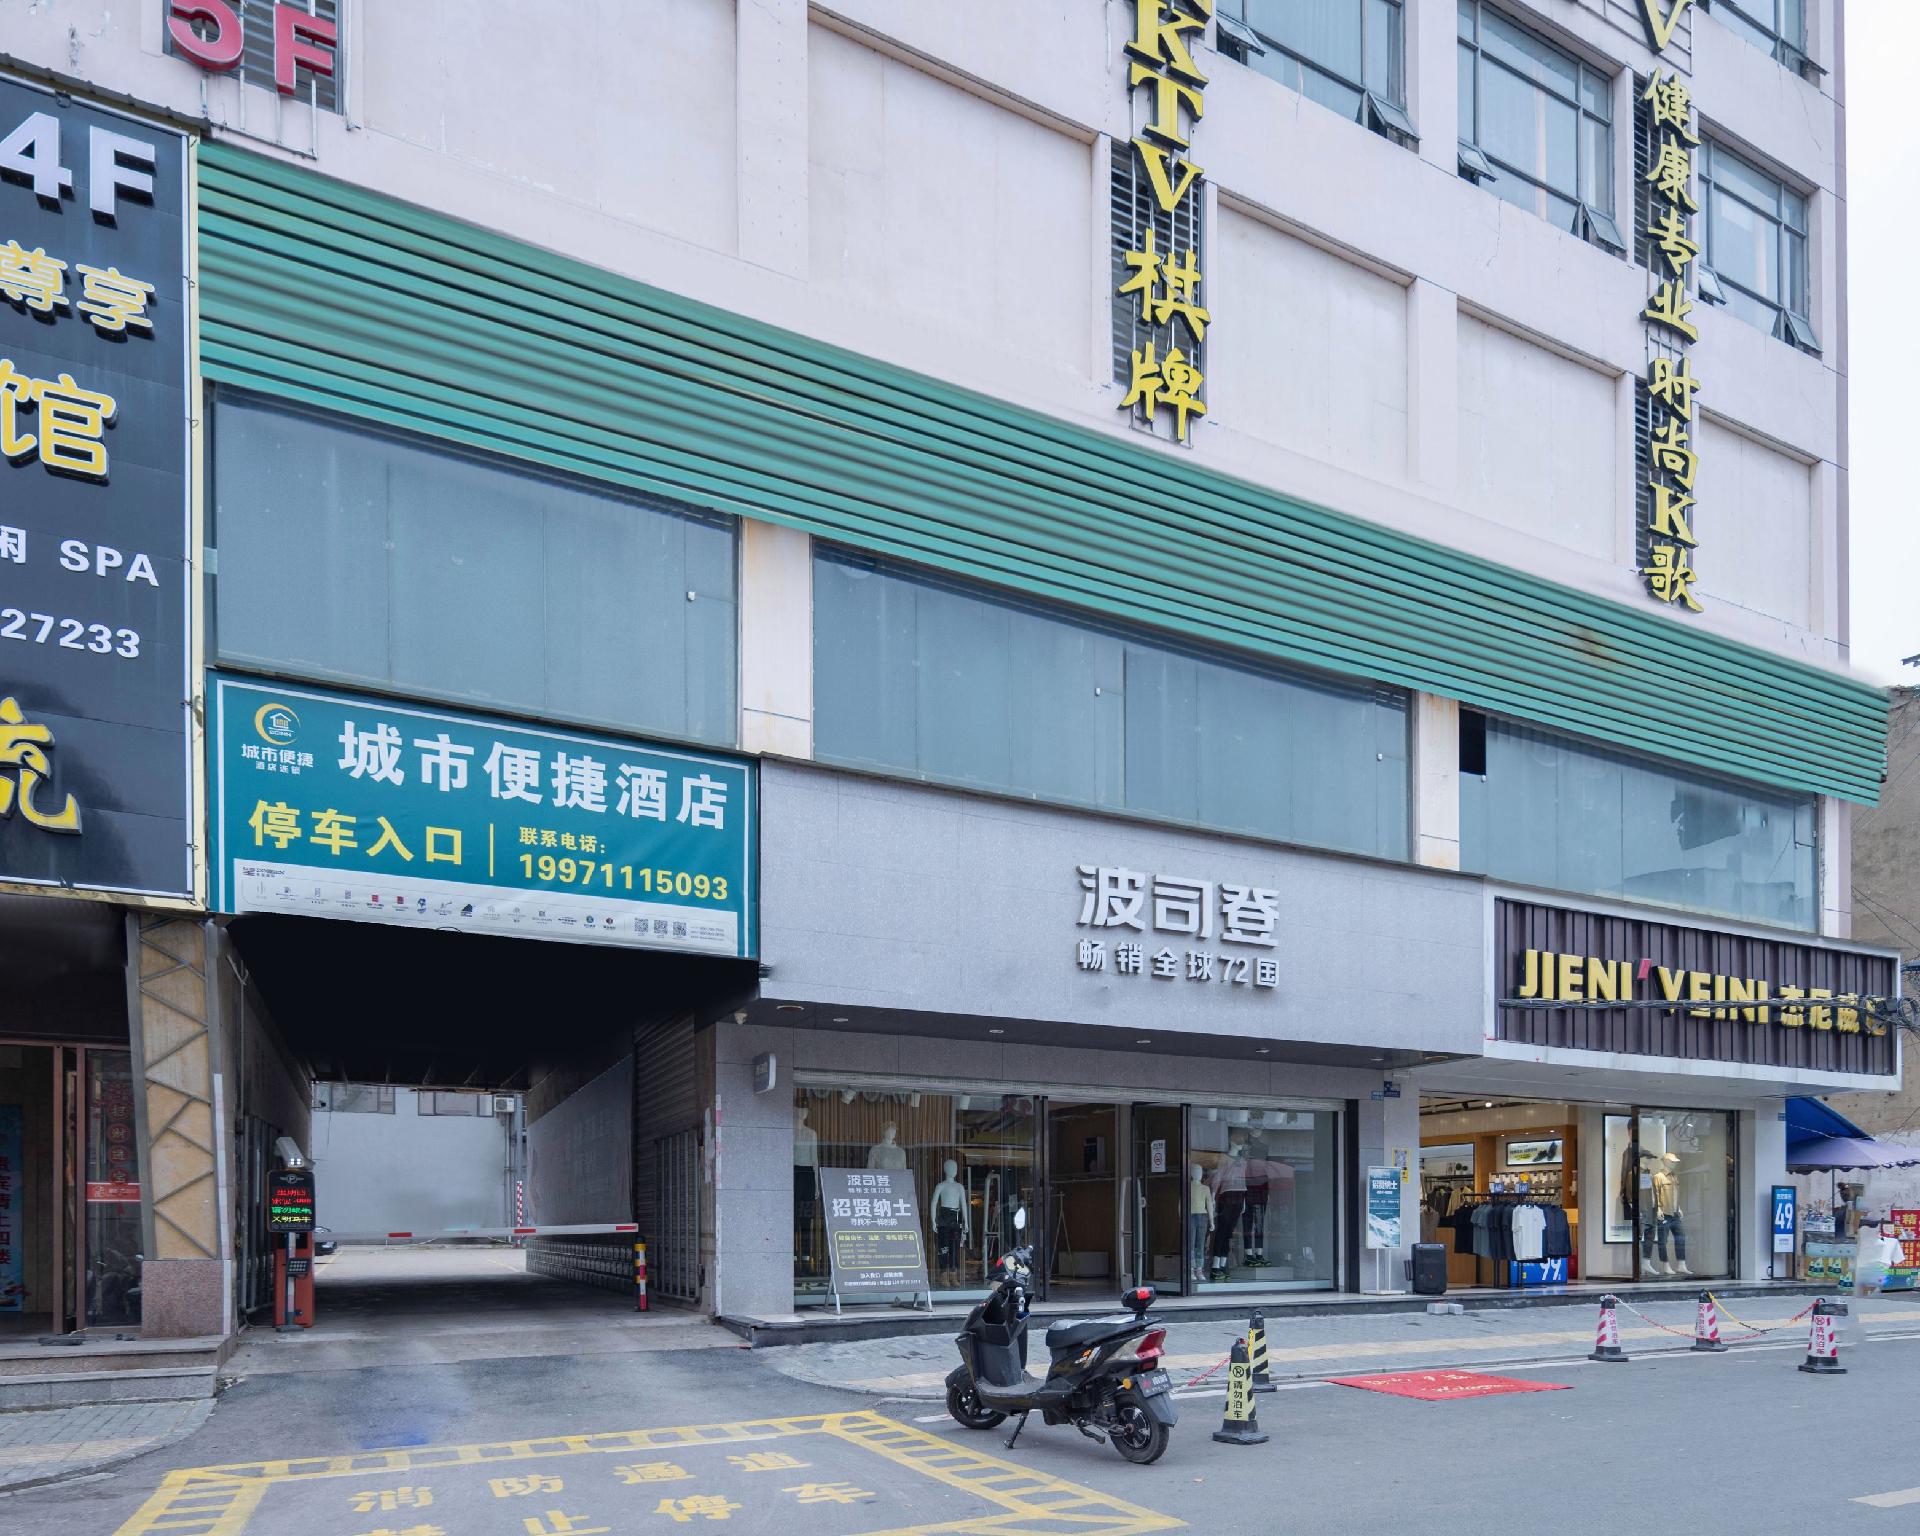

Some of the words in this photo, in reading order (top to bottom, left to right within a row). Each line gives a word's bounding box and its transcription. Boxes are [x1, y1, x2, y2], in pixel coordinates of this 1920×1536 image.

[167, 0, 338, 95] 5F
[0, 112, 156, 216] 4F
[0, 240, 155, 332] 尊享
[59, 539, 160, 588] SPA
[0, 607, 141, 659] 27233
[241, 743, 314, 768] 城市便捷
[337, 718, 729, 831] 城市便捷酒店
[248, 799, 463, 866] 停车入口
[519, 853, 728, 900] 19971115093
[1076, 864, 1280, 948] 波司登
[1078, 938, 1280, 988] 畅销全球72国
[847, 1174, 890, 1187] 波司登
[832, 1199, 911, 1217] 招贤纳士
[1233, 1380, 1243, 1419] 请勿泊车
